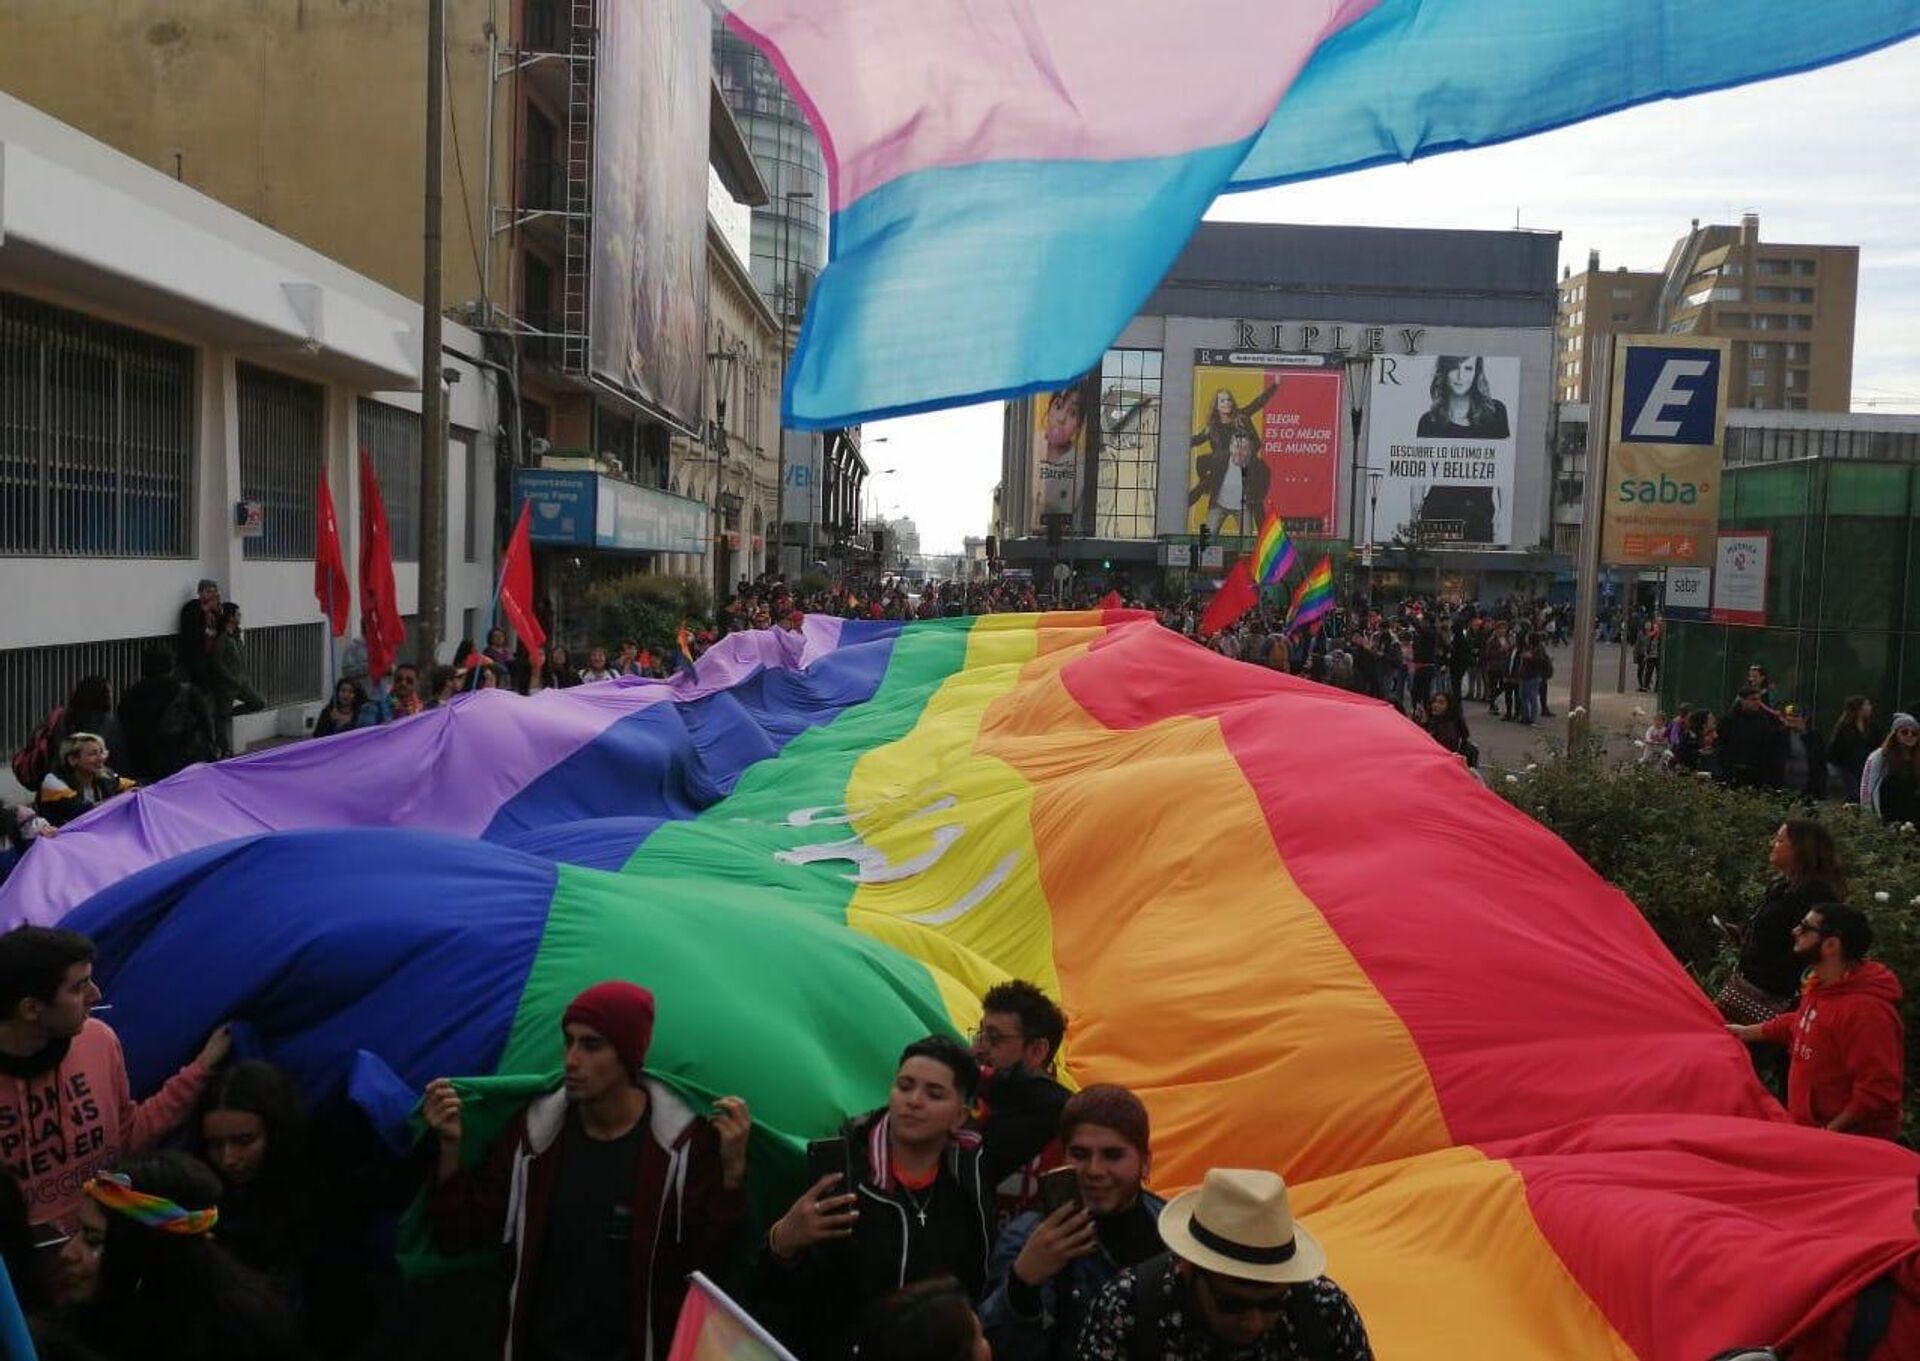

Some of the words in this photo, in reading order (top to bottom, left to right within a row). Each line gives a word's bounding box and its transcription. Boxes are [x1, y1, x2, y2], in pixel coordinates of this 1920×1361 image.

[1234, 319, 1426, 355] RIPLEY
[1379, 357, 1402, 385] R
[1630, 359, 1711, 437] E
[1265, 428, 1279, 439] ES
[1280, 429, 1296, 439] LO
[1296, 428, 1332, 441] MEJOR
[1264, 442, 1284, 454] DEL
[1285, 443, 1328, 456] MUNDO
[1390, 445, 1435, 458] DESCUBRE
[1437, 446, 1448, 458] LO
[1484, 448, 1496, 460] EN
[1390, 460, 1426, 478] MODA
[1431, 461, 1440, 478] Y
[1442, 461, 1496, 480] BELLEZA
[11, 1127, 104, 1180] NEVER
